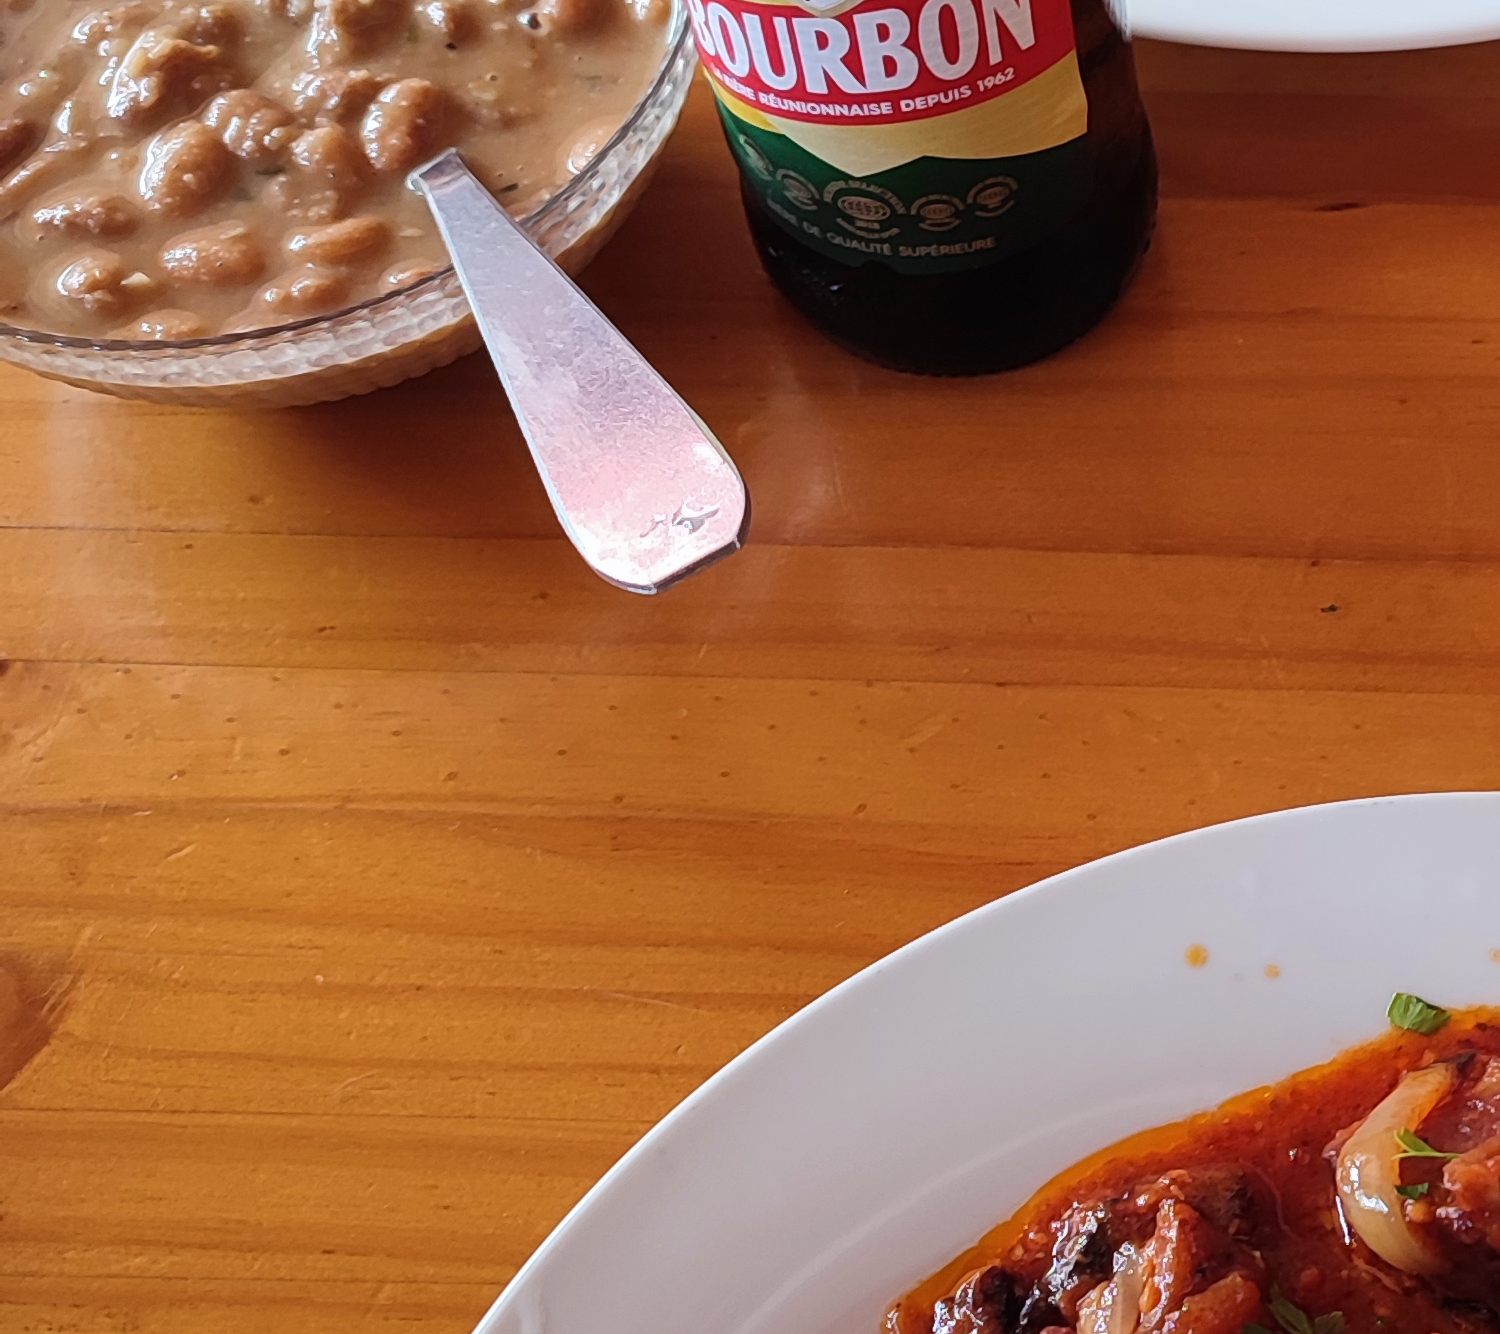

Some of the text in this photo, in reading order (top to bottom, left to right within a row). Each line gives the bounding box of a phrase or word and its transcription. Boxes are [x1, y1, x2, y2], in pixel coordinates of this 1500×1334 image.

[758, 90, 893, 117] RÉUNIONNAISE
[900, 84, 972, 113] DEPUIS
[976, 67, 1016, 94] 1962
[827, 230, 894, 257] QUALITÉ
[898, 236, 997, 257] SUPÉRIEURE
